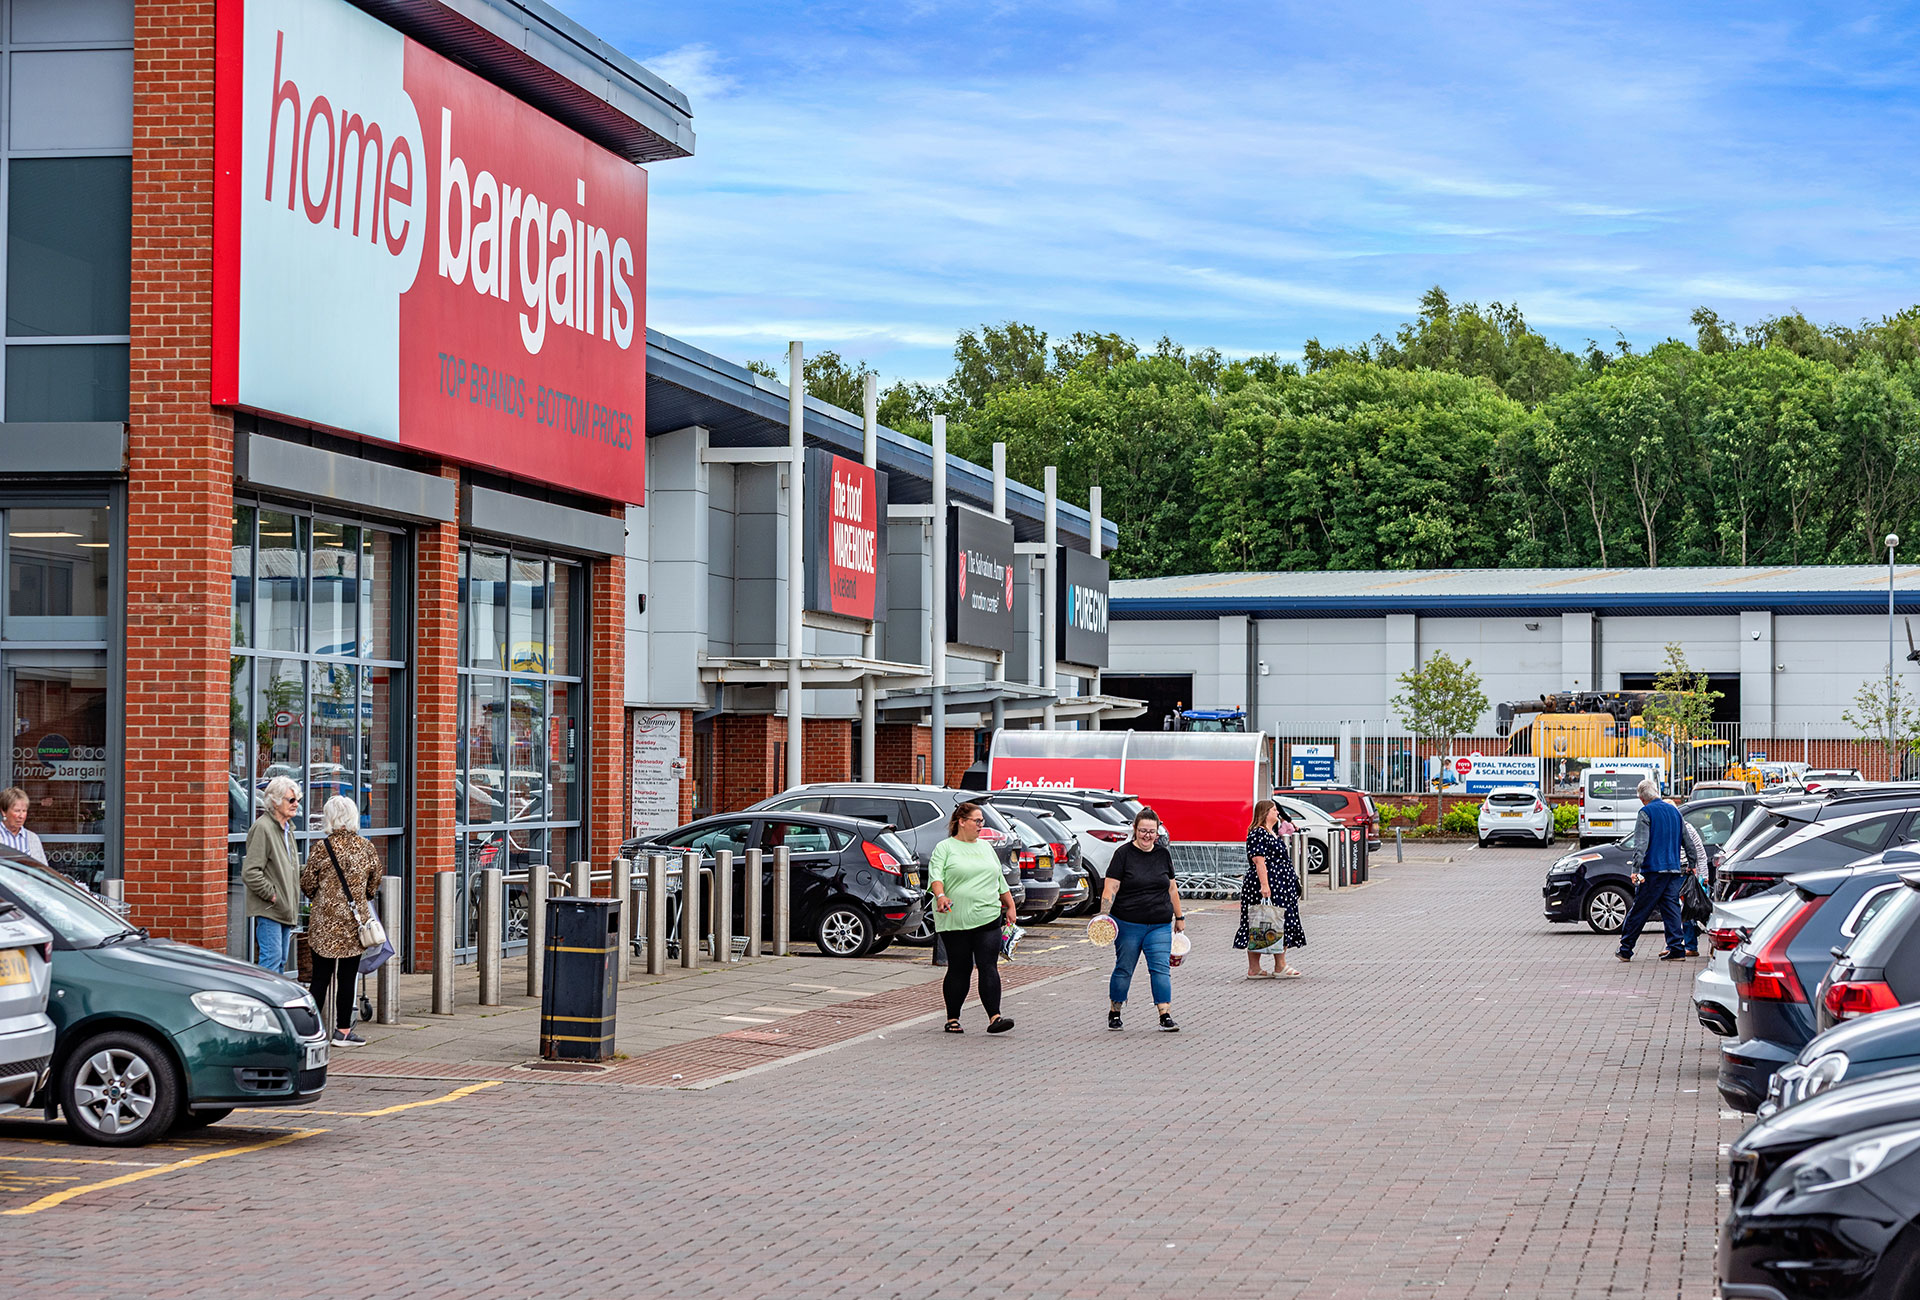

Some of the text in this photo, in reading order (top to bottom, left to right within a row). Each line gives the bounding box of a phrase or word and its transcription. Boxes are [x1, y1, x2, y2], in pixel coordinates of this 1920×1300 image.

[264, 30, 635, 354] home bargains
[438, 352, 467, 398] TOP
[470, 363, 526, 418] BRANDS
[537, 385, 589, 440] BOTTOM
[591, 404, 633, 451] PRICES
[834, 470, 863, 522] the food
[833, 521, 875, 574] WAREHOUSE
[967, 549, 1005, 587] The Salvation Army
[837, 572, 857, 600] Iceland
[1075, 584, 1107, 634] PUREGYM
[637, 715, 676, 734] Slimming
[14, 763, 52, 776] home
